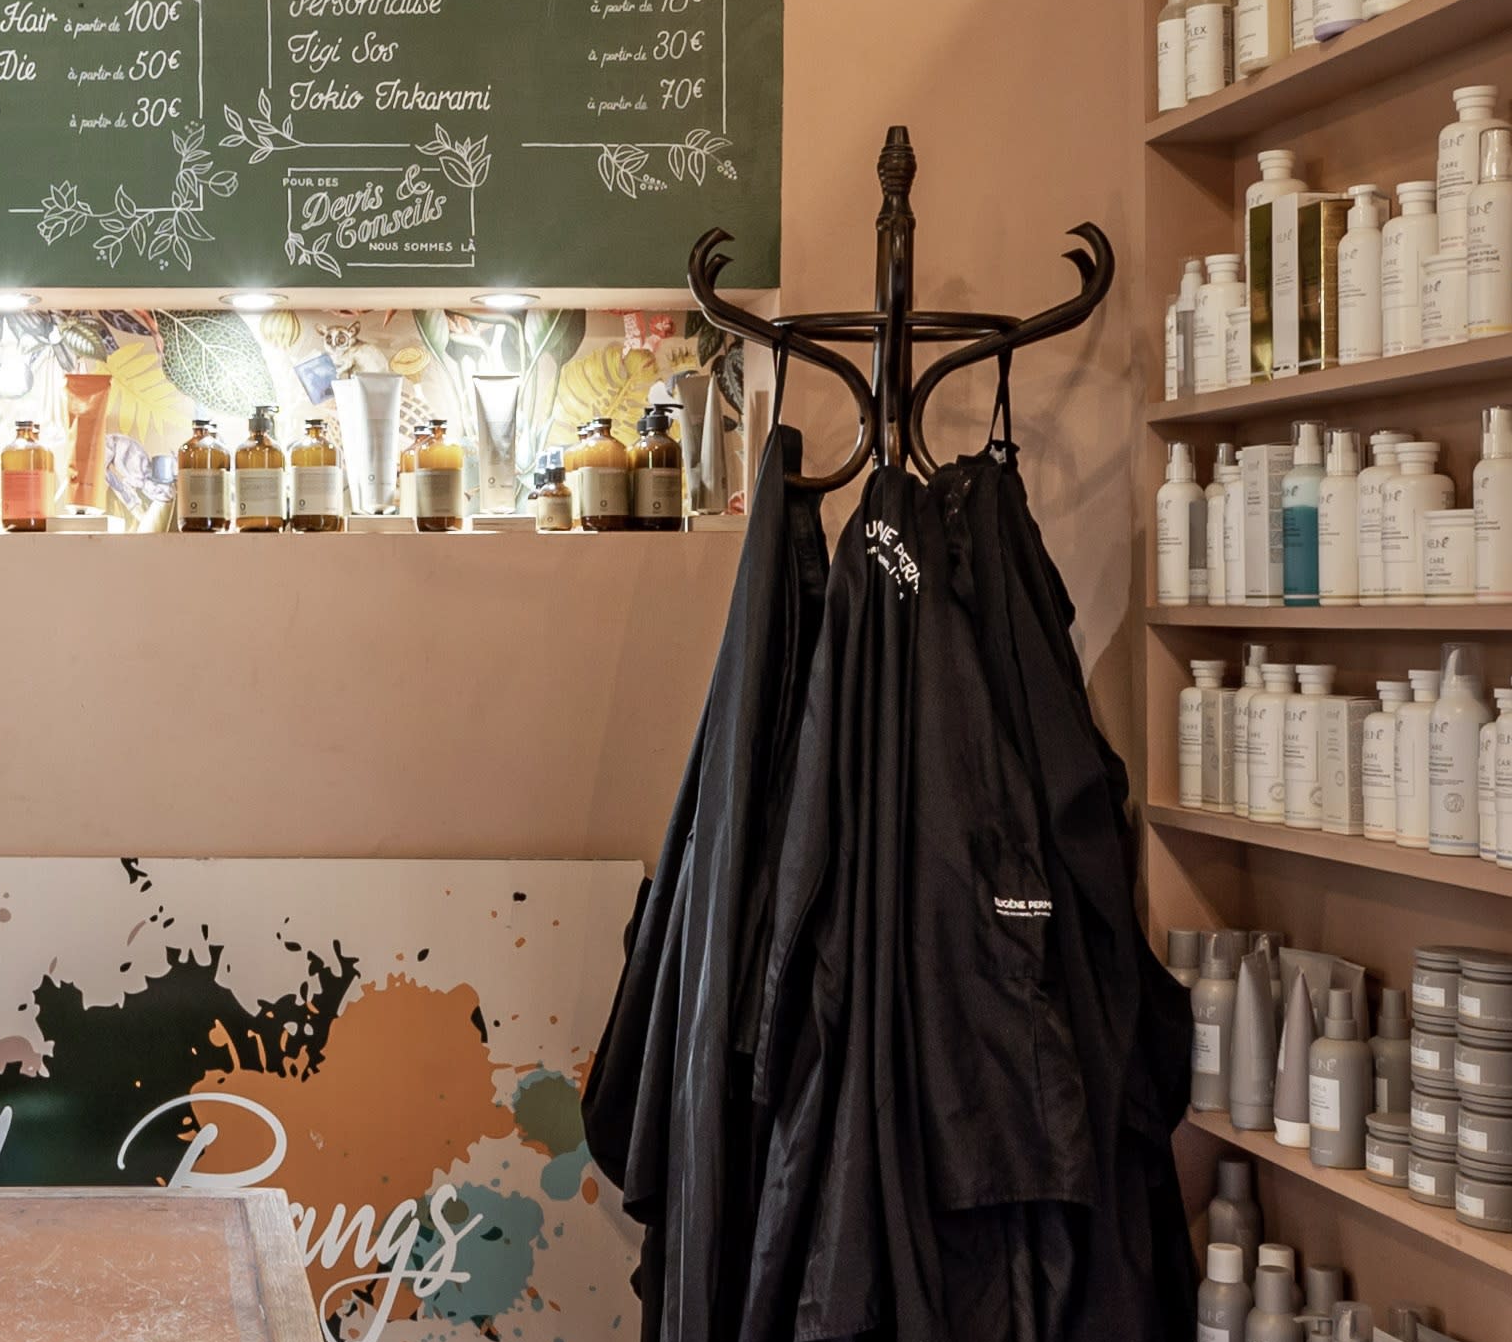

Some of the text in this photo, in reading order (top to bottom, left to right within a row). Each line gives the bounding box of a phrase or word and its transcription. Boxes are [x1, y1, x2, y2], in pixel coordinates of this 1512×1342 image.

[0, 0, 59, 33] Hair
[107, 15, 121, 33] de
[123, 0, 183, 33] 100€
[112, 64, 126, 81] de
[128, 49, 182, 81] 50€
[287, 30, 343, 73] Tigi
[351, 31, 400, 64] Sos
[633, 44, 648, 62] de
[652, 29, 706, 61] 30€
[289, 80, 365, 111] Tokio
[633, 94, 648, 111] de
[659, 77, 706, 110] 70€
[113, 111, 129, 129] de
[131, 96, 182, 128] 30€
[282, 177, 339, 188] POUR DES
[301, 164, 432, 232] Devis &
[335, 191, 448, 251] Conseils
[368, 237, 477, 253] NOUS SOMMES LÀ
